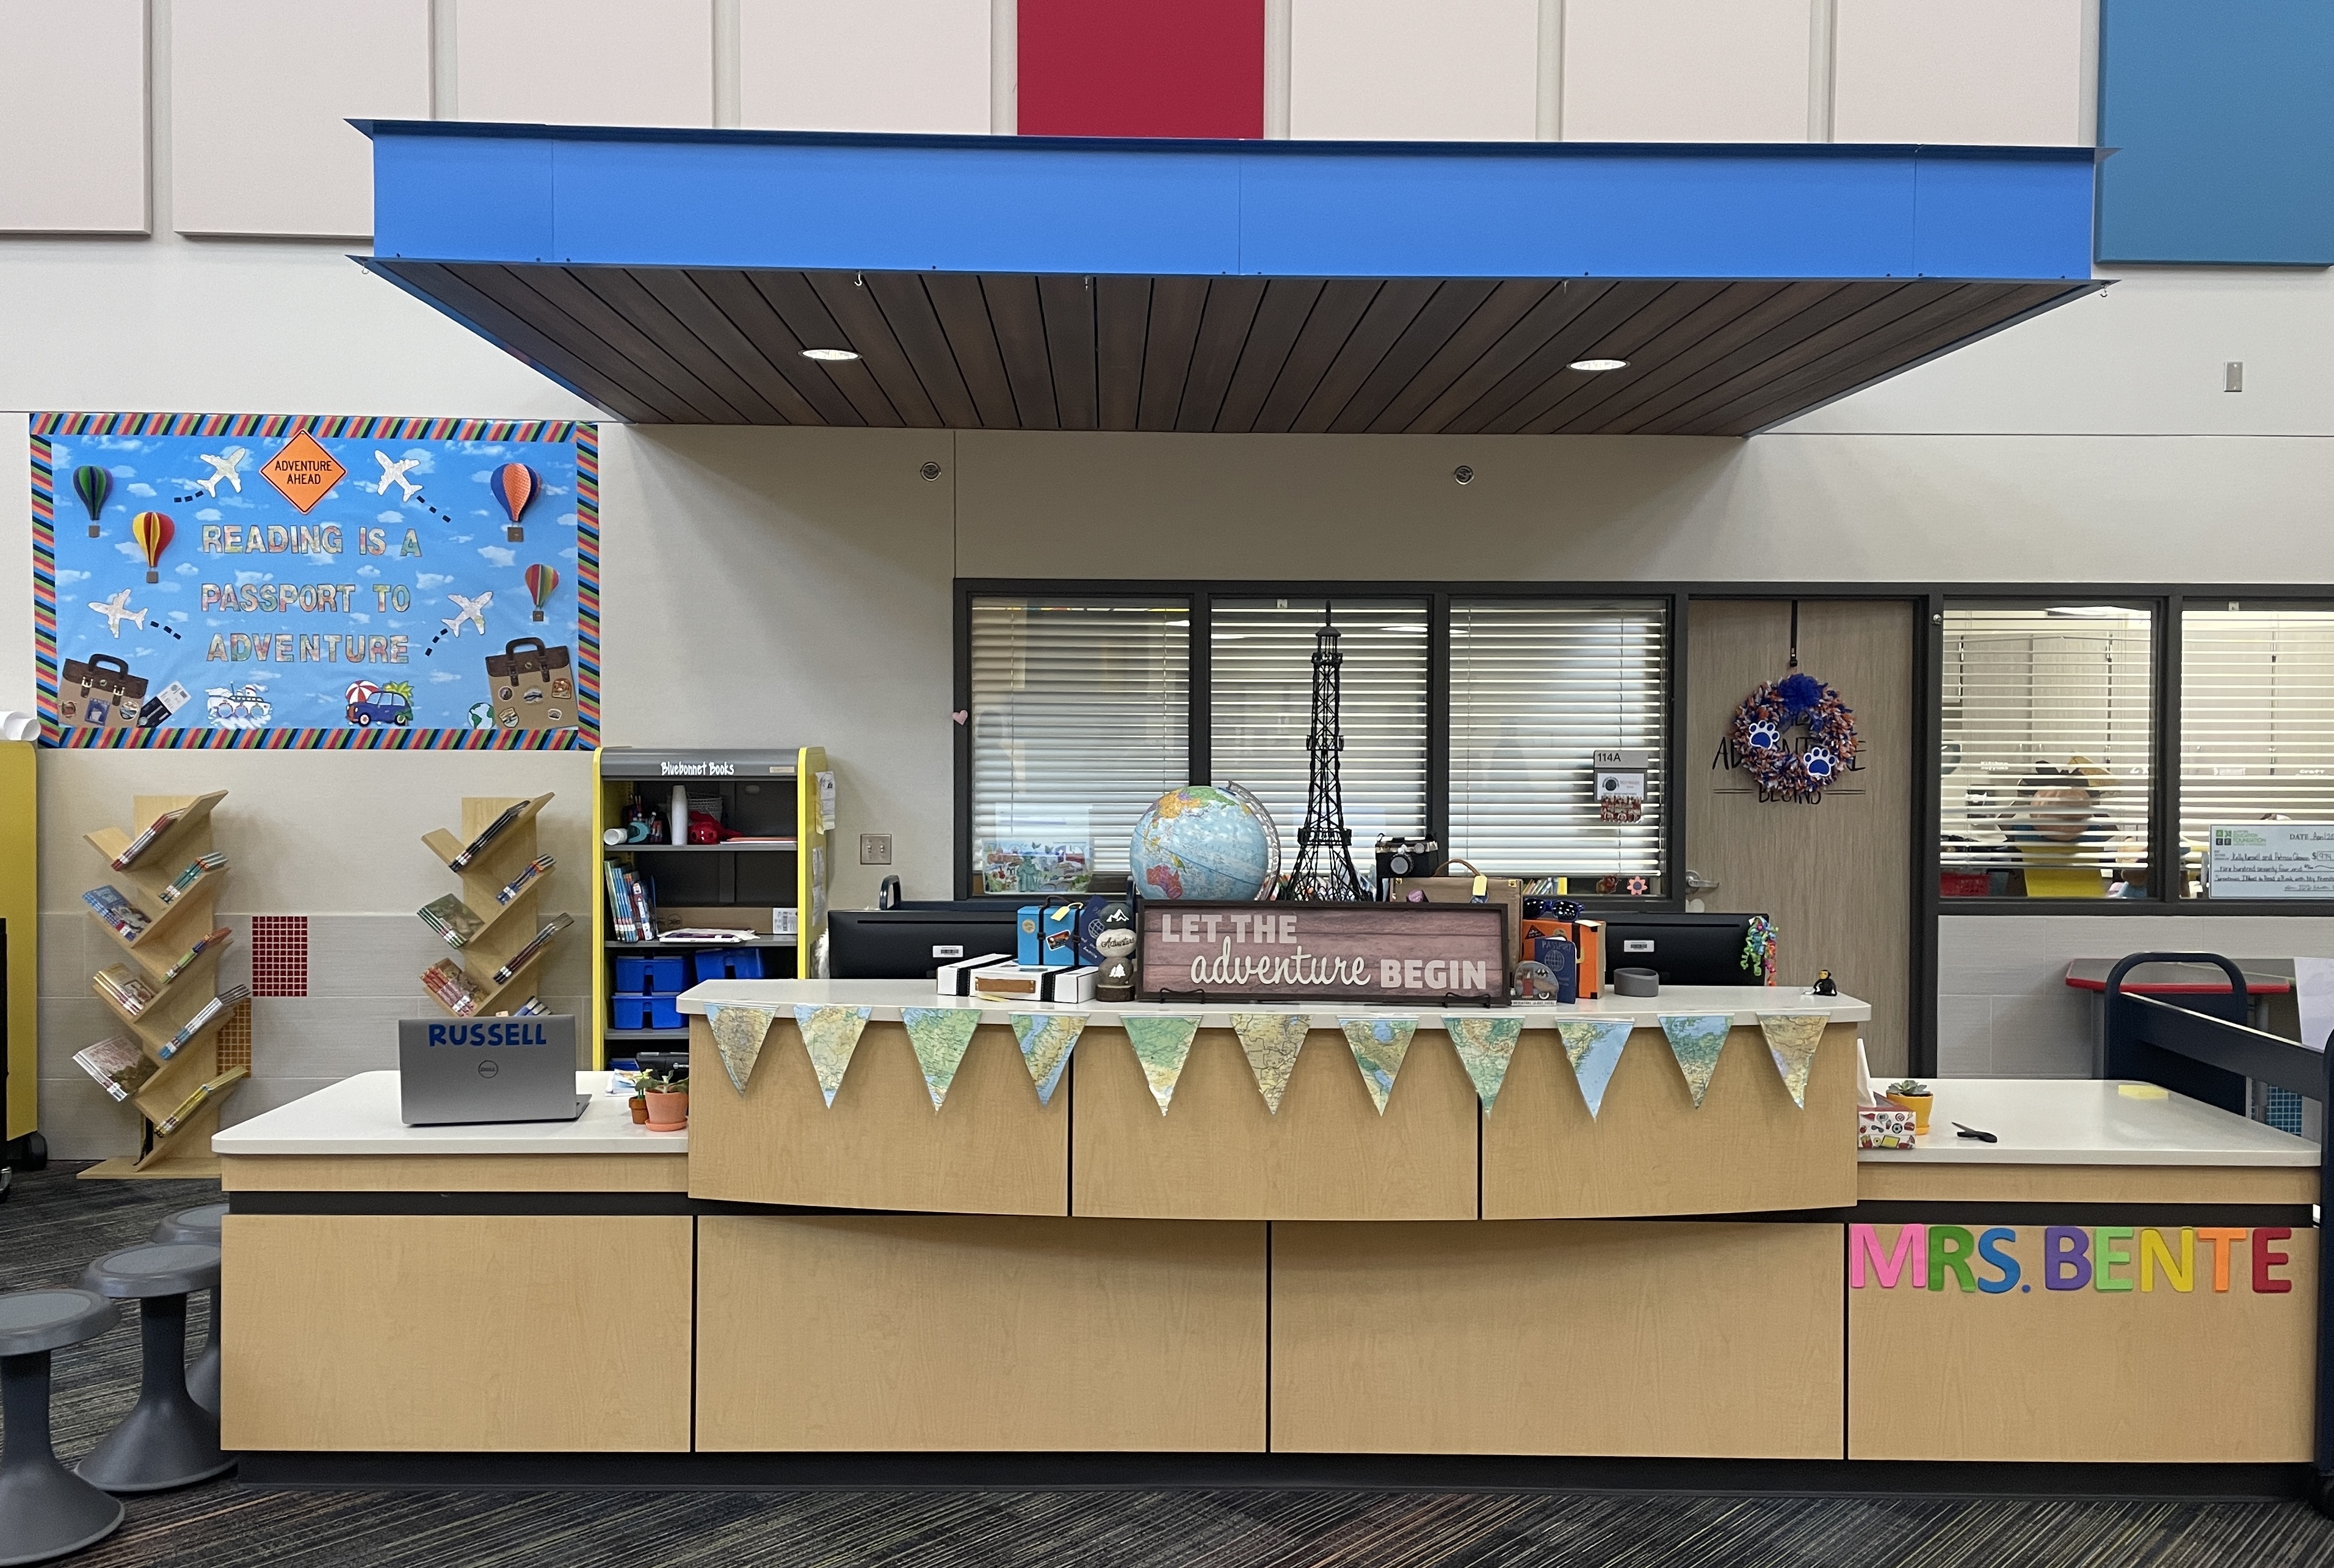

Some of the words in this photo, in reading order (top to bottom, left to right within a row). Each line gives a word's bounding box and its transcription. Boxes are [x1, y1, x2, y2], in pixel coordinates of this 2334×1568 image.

[275, 460, 333, 471] ADVENTURE
[286, 474, 321, 485] AHEAD
[202, 524, 343, 554] READING
[359, 527, 386, 555] IS
[399, 528, 422, 557] A
[201, 583, 355, 613] PASSPORT
[372, 584, 410, 612] TO
[206, 633, 409, 663] ADVENTURE
[661, 761, 707, 776] Bluebonnet
[708, 761, 734, 776] Books
[1597, 753, 1622, 762] 114A
[1162, 914, 1222, 943] LET
[1230, 914, 1297, 944] THE
[1191, 936, 1371, 985] adventure
[1380, 959, 1487, 989] BEGIN
[429, 1023, 547, 1047] RUSSELL
[1850, 1223, 2031, 1295] MRS.
[2044, 1226, 2292, 1294] BENTE
